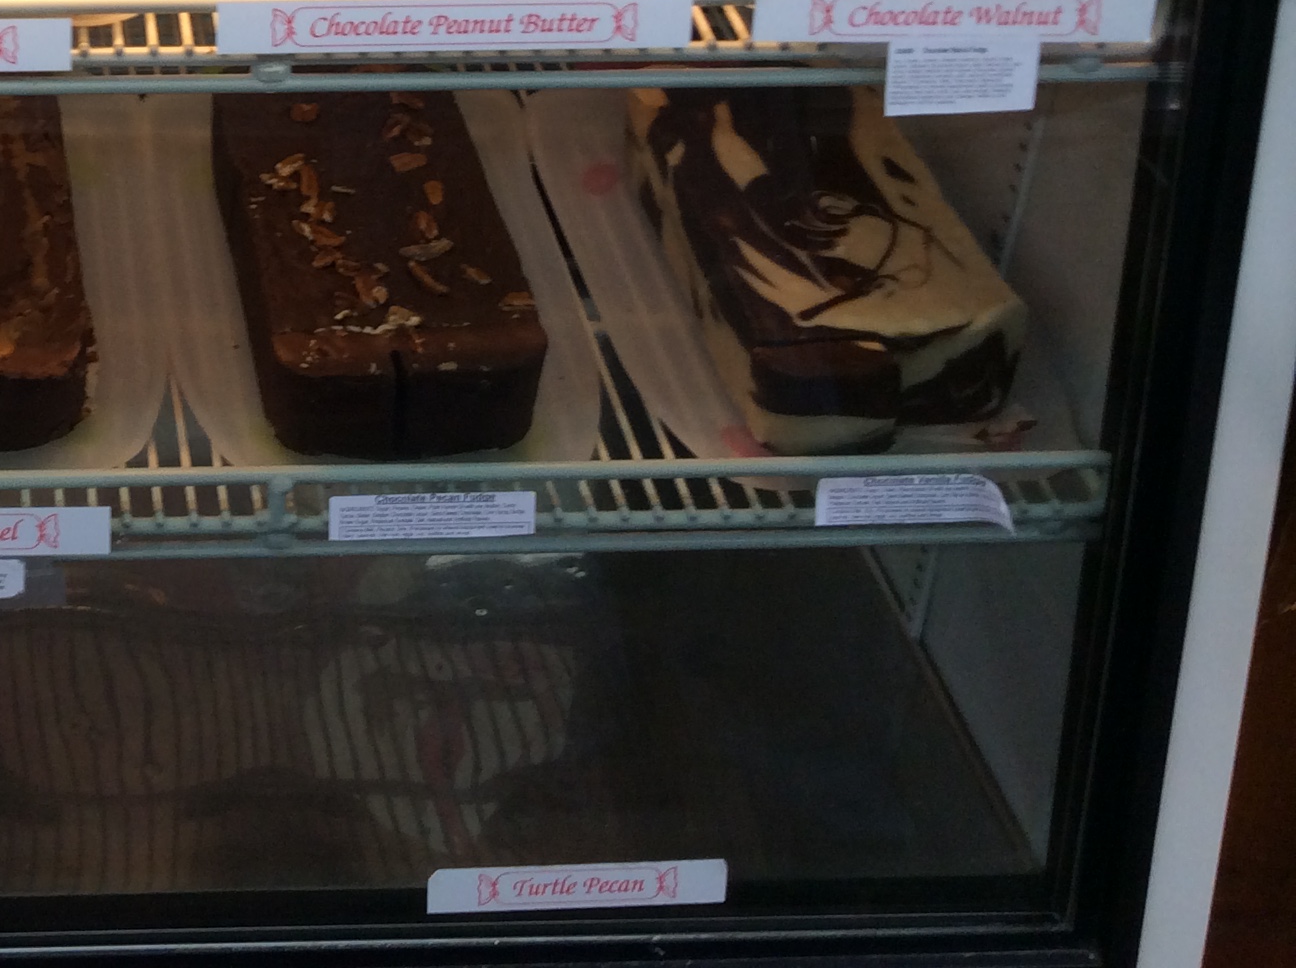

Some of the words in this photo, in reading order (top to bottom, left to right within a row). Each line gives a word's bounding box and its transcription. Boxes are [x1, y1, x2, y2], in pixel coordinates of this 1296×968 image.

[309, 11, 421, 39] Chocolate
[427, 12, 515, 36] Peanut
[518, 11, 600, 35] Butter
[847, 0, 964, 28] Chocolate
[968, 0, 1065, 28] Walnut
[512, 874, 577, 898] Turtle
[582, 876, 646, 895] Pecan
